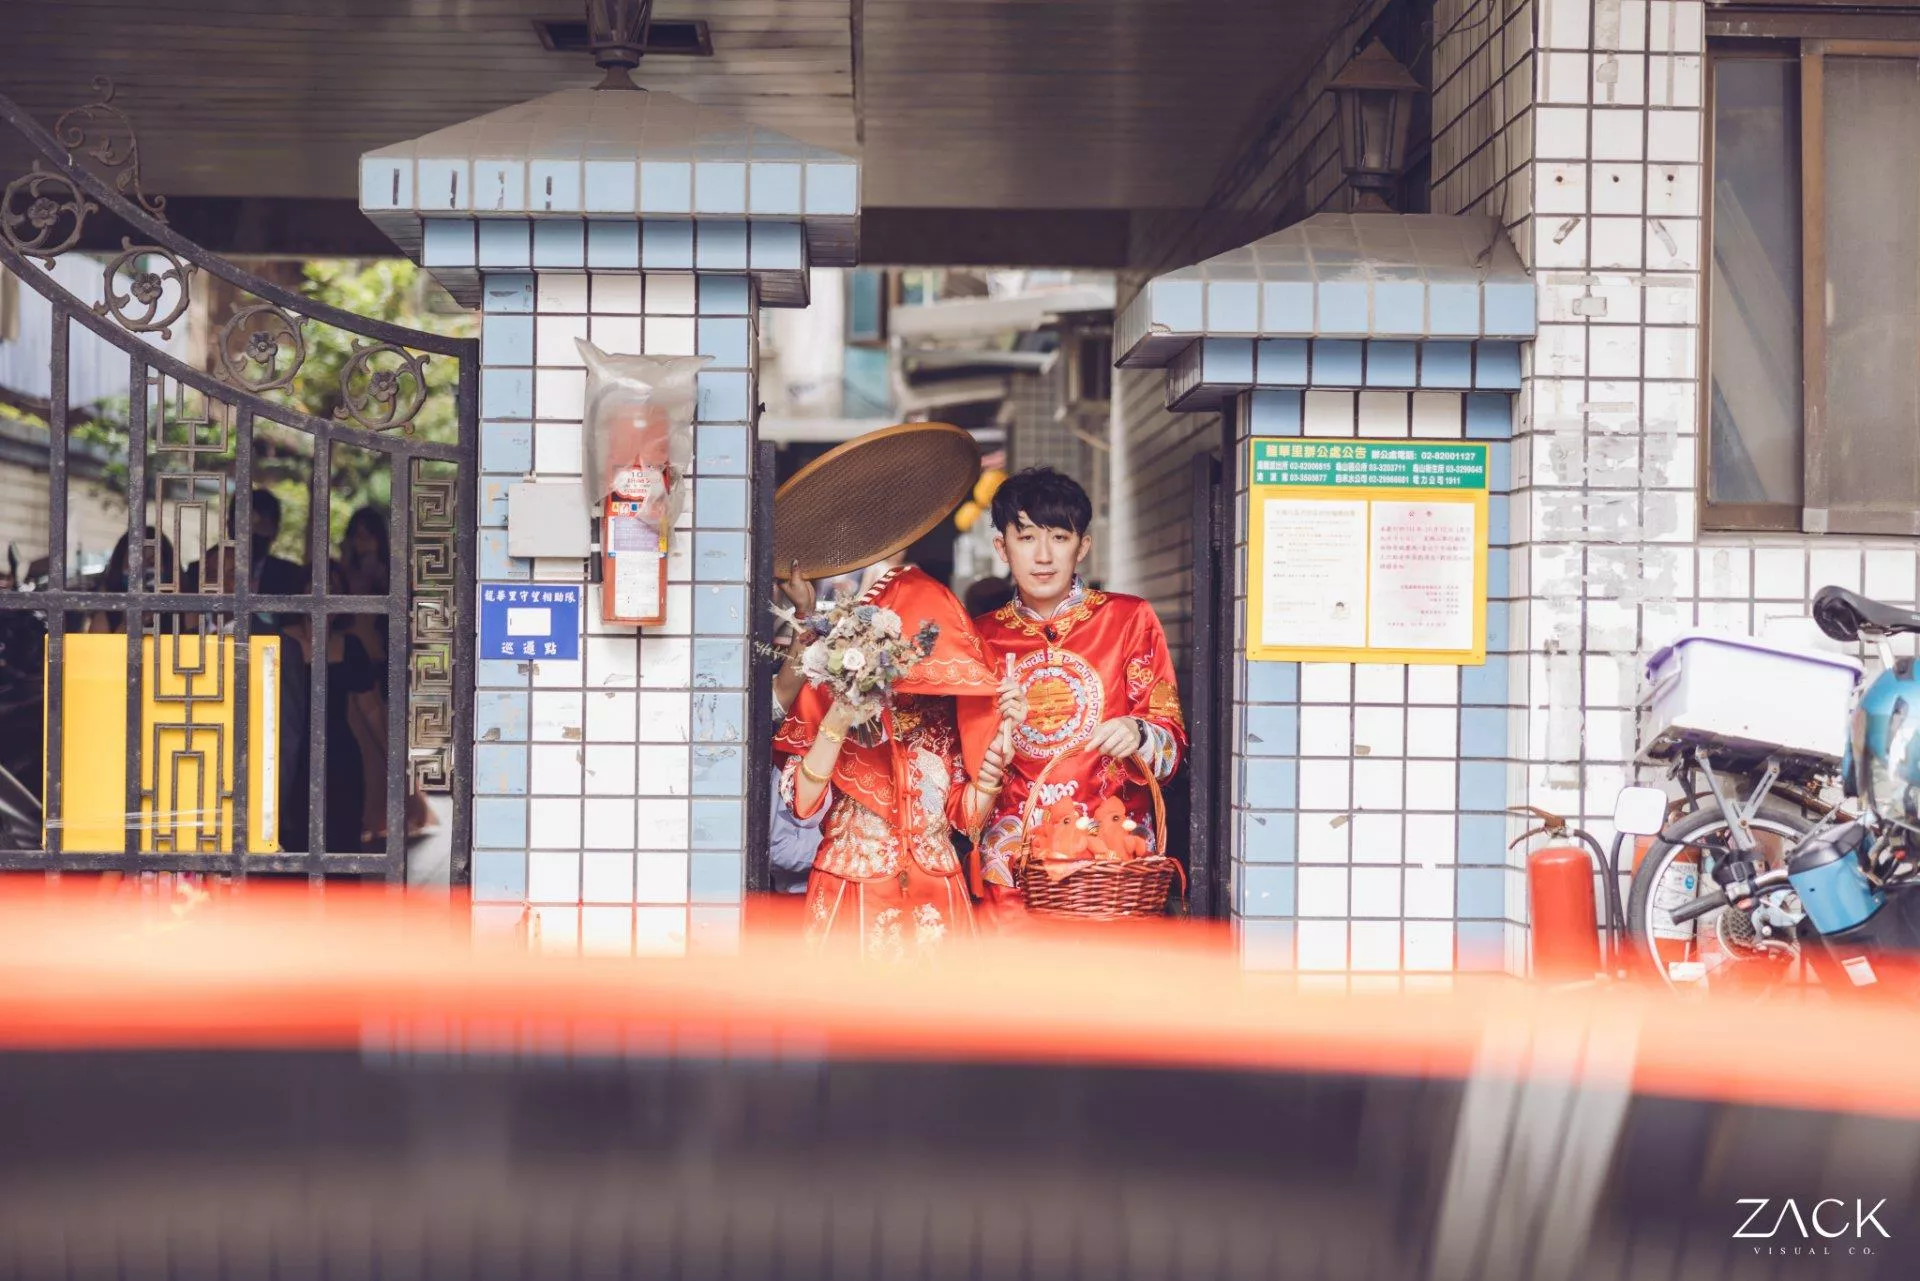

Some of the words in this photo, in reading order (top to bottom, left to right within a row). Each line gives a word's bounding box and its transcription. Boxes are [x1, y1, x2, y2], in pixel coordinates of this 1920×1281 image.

[484, 589, 576, 604] 龍華里守望相助隊
